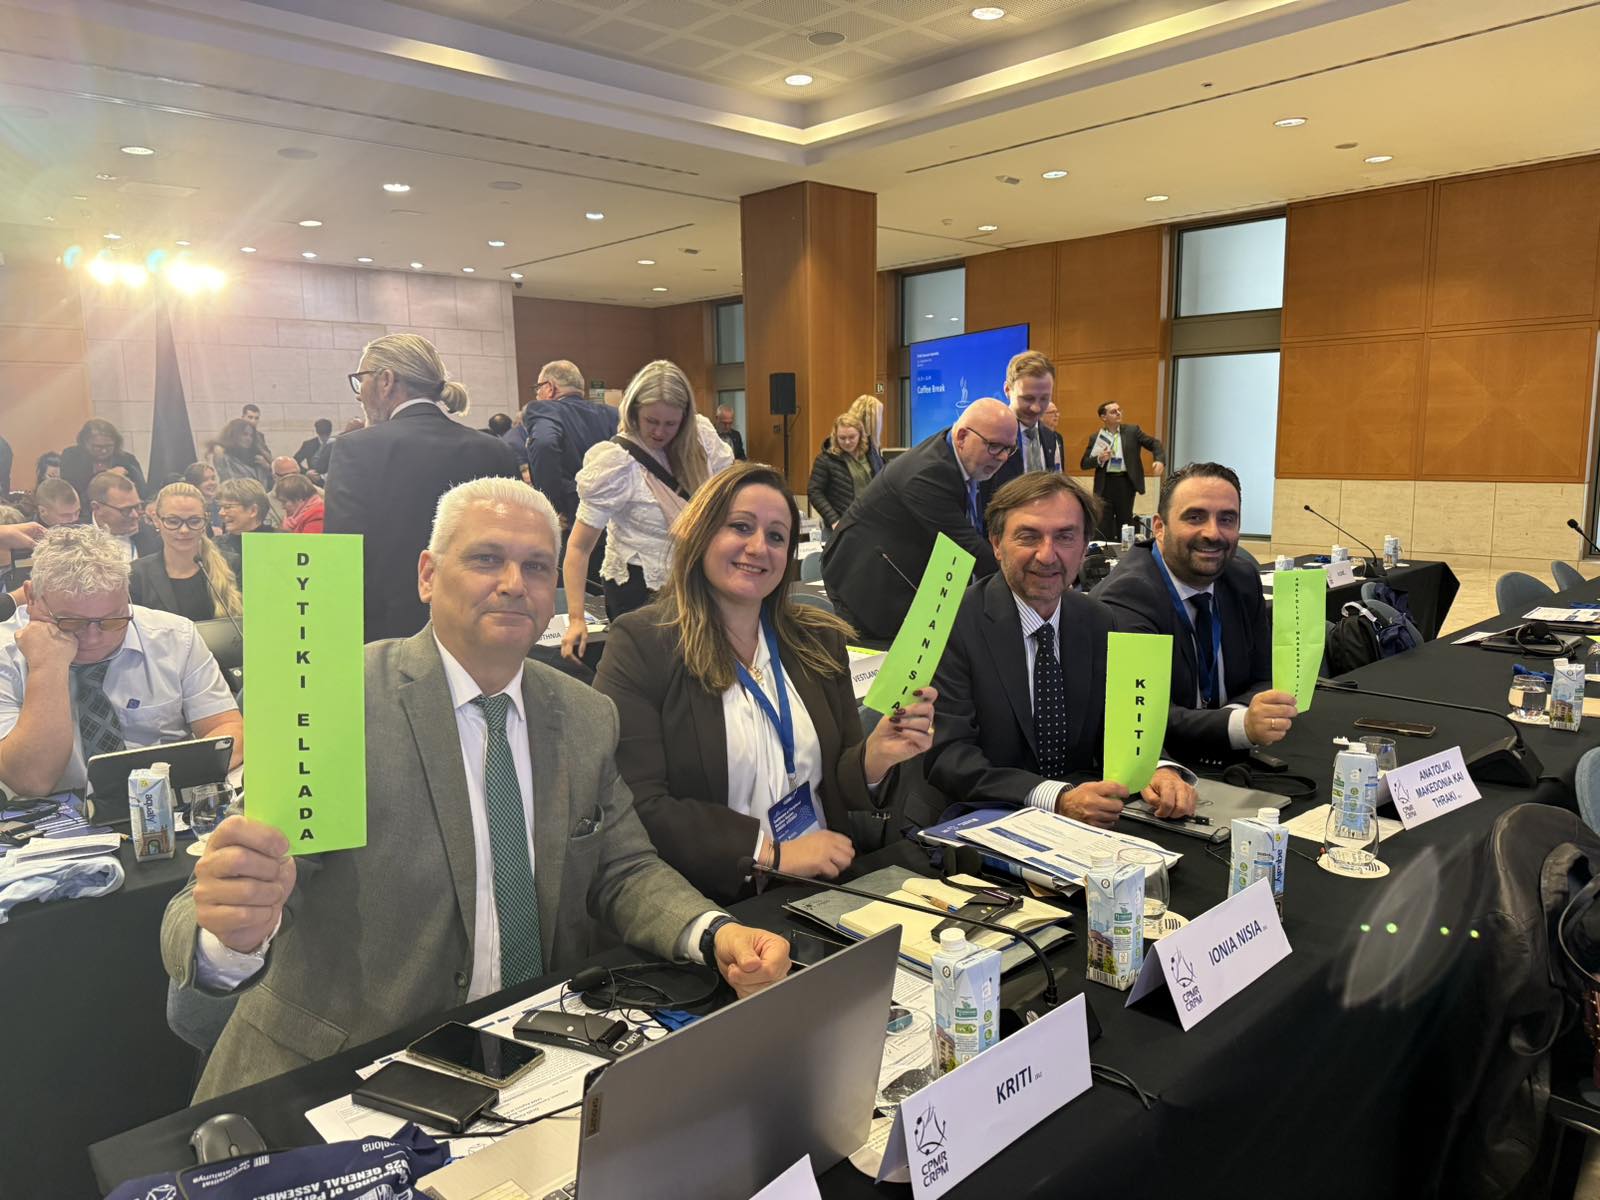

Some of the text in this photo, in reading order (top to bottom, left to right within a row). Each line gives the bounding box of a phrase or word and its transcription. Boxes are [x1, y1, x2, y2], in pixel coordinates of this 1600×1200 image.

[296, 553, 314, 840] DYTIKI ELLADA
[1134, 679, 1146, 756] KRITI
[1419, 760, 1452, 780] ANATOLIKI
[1415, 771, 1464, 798] MAKEDONIA KAI
[1432, 791, 1457, 808] THRAKI
[1208, 919, 1263, 966] IONIA NISIA
[1182, 985, 1200, 1003] CPMR
[1185, 995, 1204, 1012] CRPM
[996, 1065, 1032, 1105] KRITI
[921, 1150, 948, 1176] CPMR
[923, 1163, 950, 1188] CRPM
[324, 1166, 382, 1186] GENERAL
[253, 1181, 320, 1200] ASSEMBL
